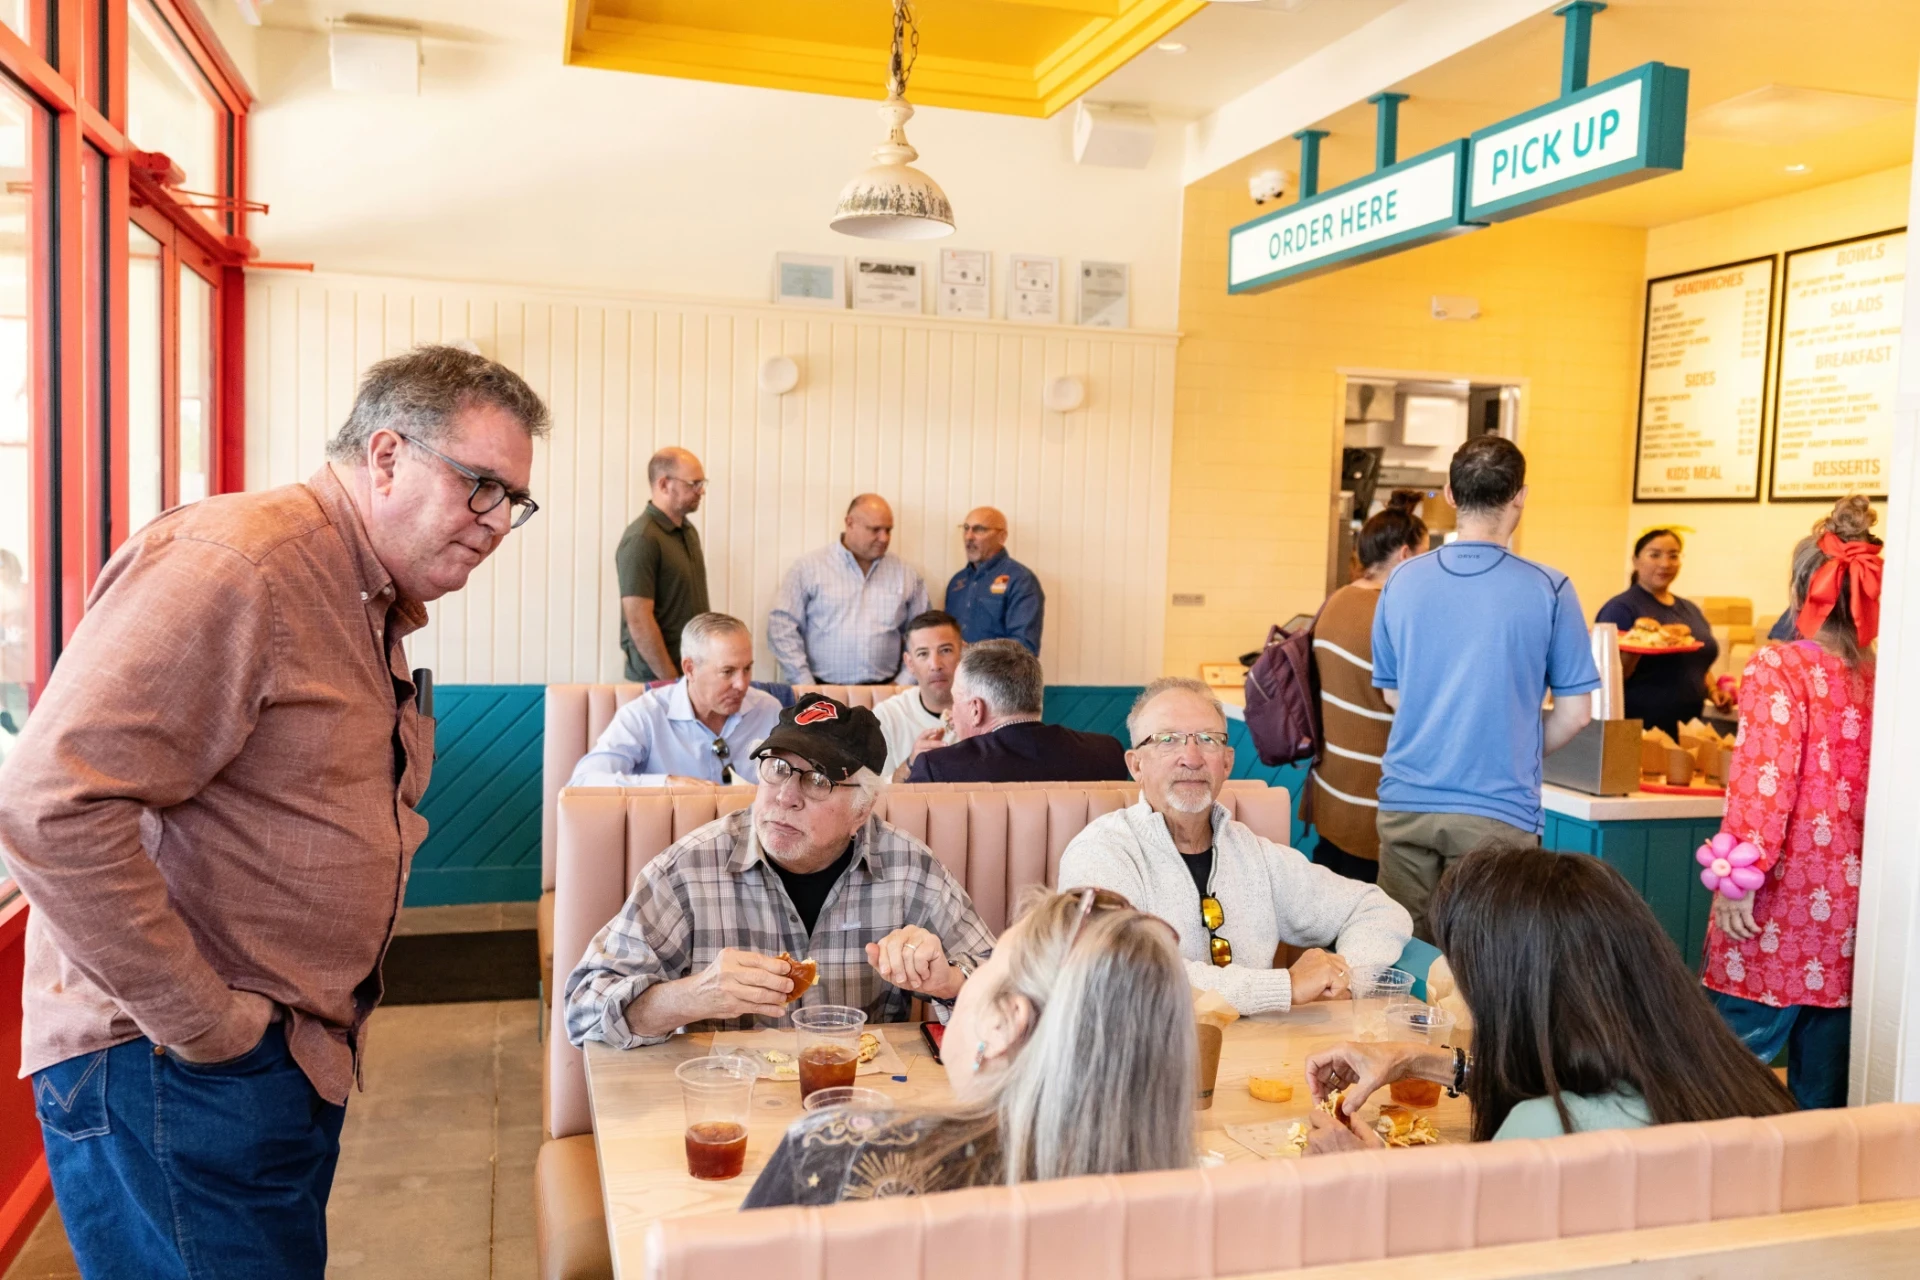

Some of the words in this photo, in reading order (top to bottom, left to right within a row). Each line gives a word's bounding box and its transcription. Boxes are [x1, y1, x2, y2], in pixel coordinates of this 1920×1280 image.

[1491, 128, 1562, 186] PICK
[1573, 108, 1620, 158] UP
[1268, 212, 1333, 260] ORDER
[1340, 189, 1398, 237] HERE
[1836, 243, 1885, 266] BOWLS
[1673, 272, 1744, 297] SANDWICHES
[1830, 293, 1884, 318] SALADS
[1815, 345, 1892, 370] BREAKFAST
[1684, 371, 1716, 388] SIDES
[1665, 467, 1691, 481] KIDS
[1693, 466, 1723, 480] MEAL
[1812, 459, 1881, 477] DESSERTS
